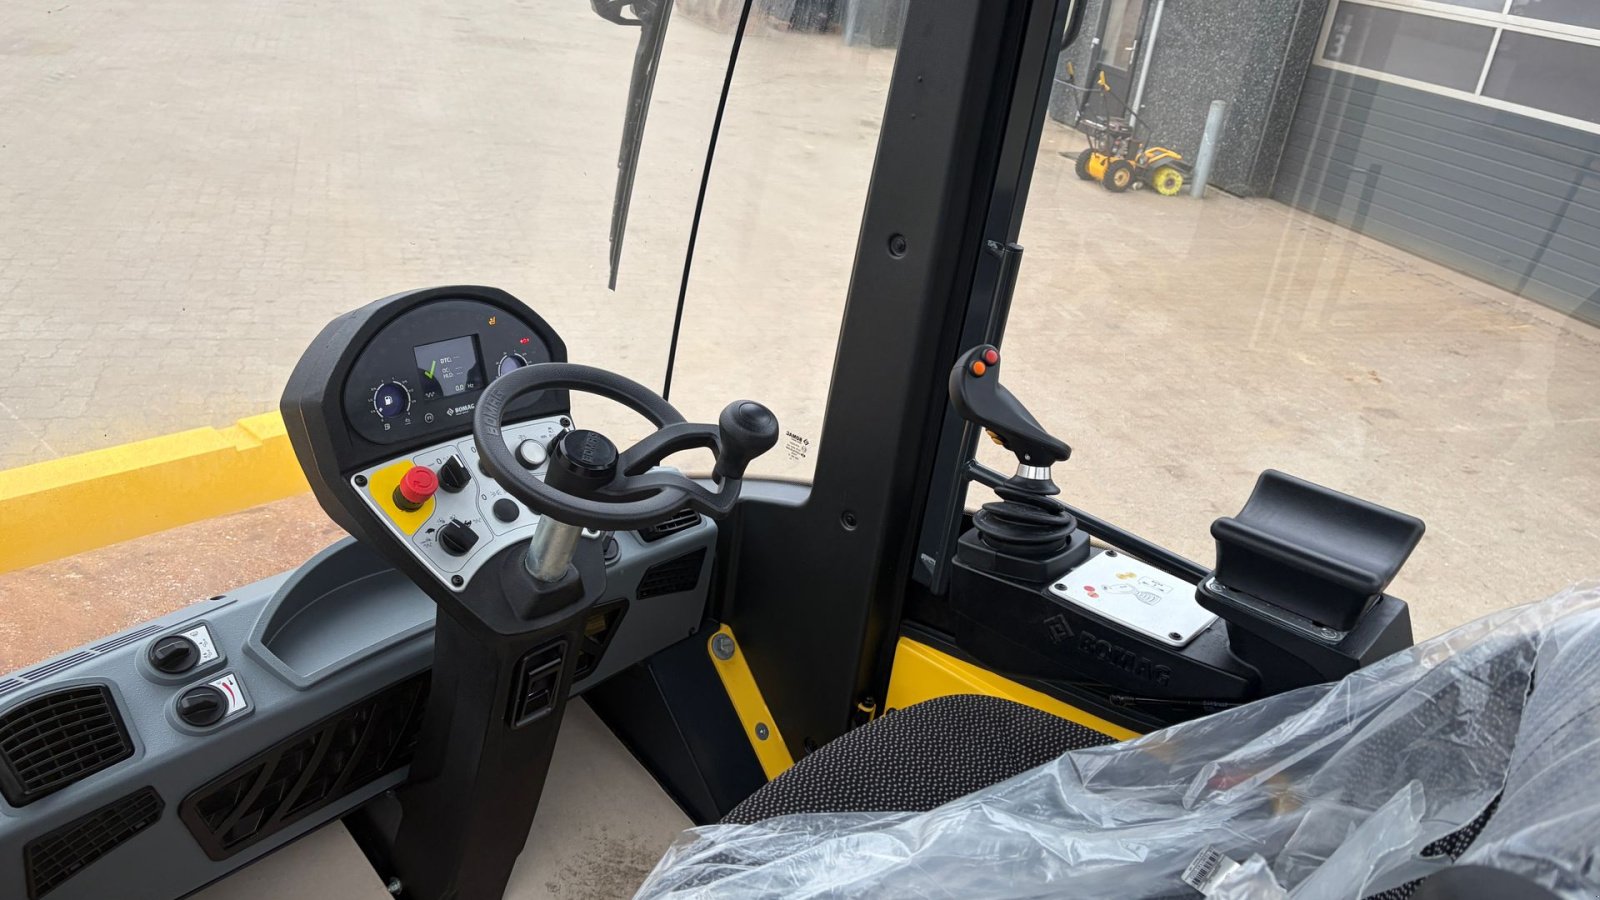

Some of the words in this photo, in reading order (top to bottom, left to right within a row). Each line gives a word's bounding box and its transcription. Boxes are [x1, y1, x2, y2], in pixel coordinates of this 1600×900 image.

[454, 403, 475, 413] BOMAG
[482, 388, 504, 436] BOMAG
[1078, 630, 1172, 688] BOMAG
